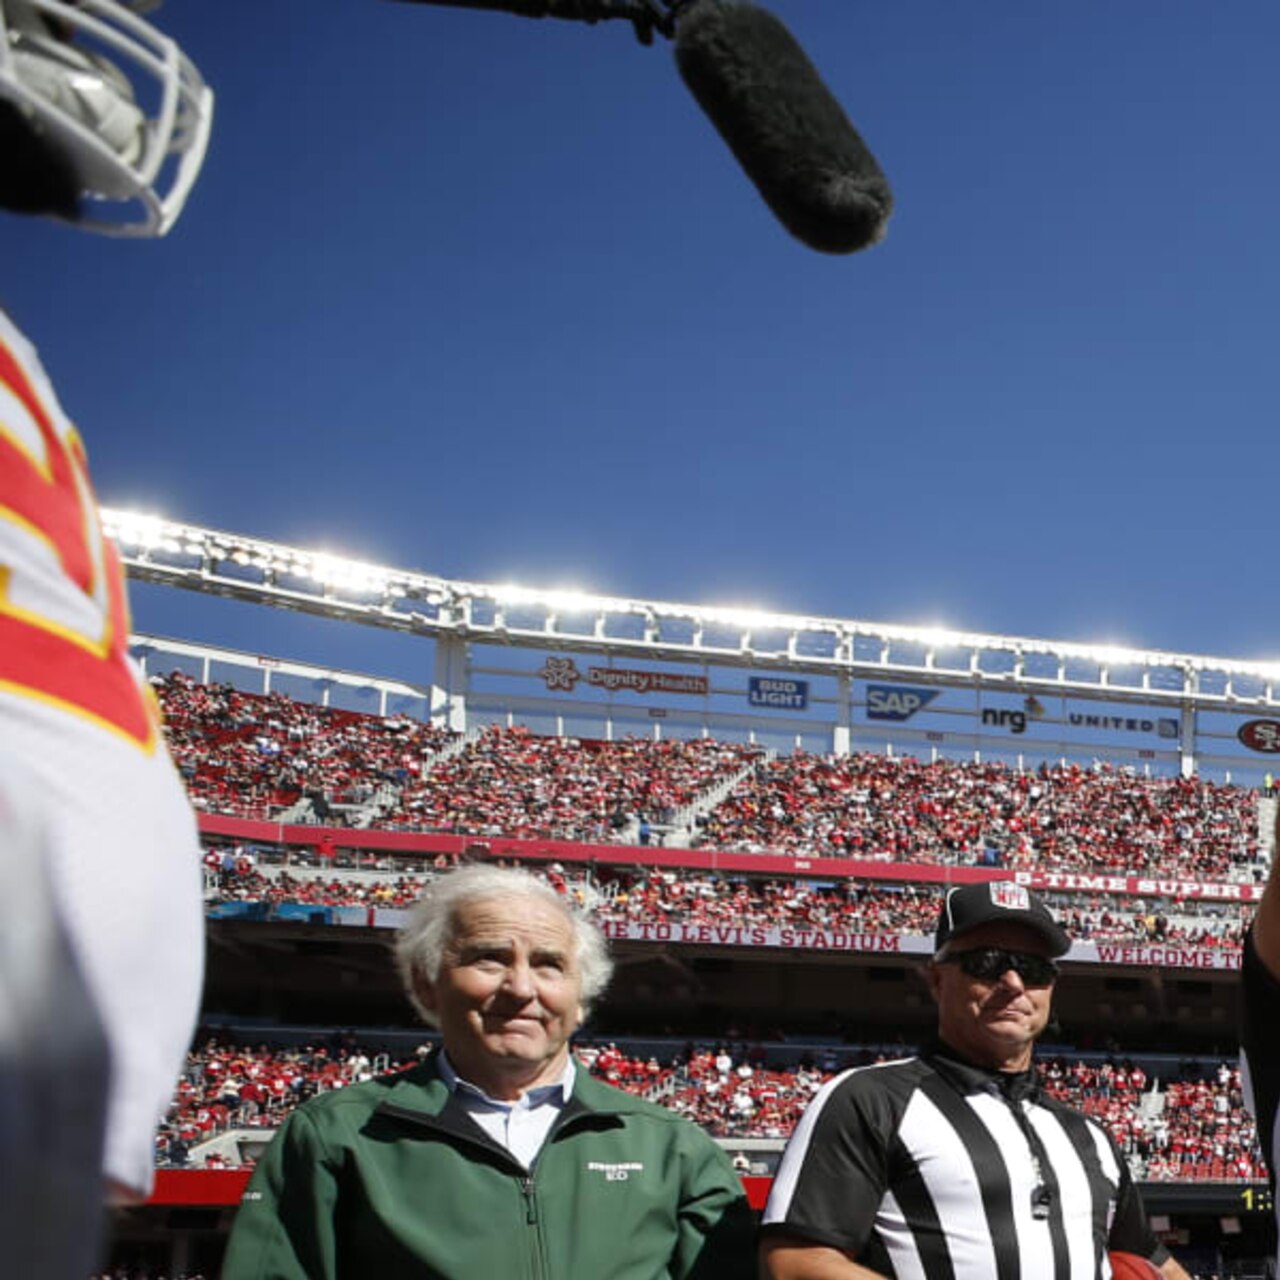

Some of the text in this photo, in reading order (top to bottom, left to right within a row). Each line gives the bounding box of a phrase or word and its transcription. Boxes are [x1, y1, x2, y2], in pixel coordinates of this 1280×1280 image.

[590, 669, 705, 692] Dignity Health
[759, 680, 796, 692] BUD
[752, 690, 802, 705] LIGHT
[870, 690, 920, 715] SAP
[982, 708, 1027, 733] nrg
[1070, 713, 1154, 733] UNITED
[1015, 872, 1127, 891] 5-TIME
[1137, 880, 1240, 899] SUPER
[637, 923, 671, 939] TO
[681, 925, 766, 944] LEVI'S
[780, 930, 900, 950] STADIUM
[1097, 946, 1215, 967] WELCOME
